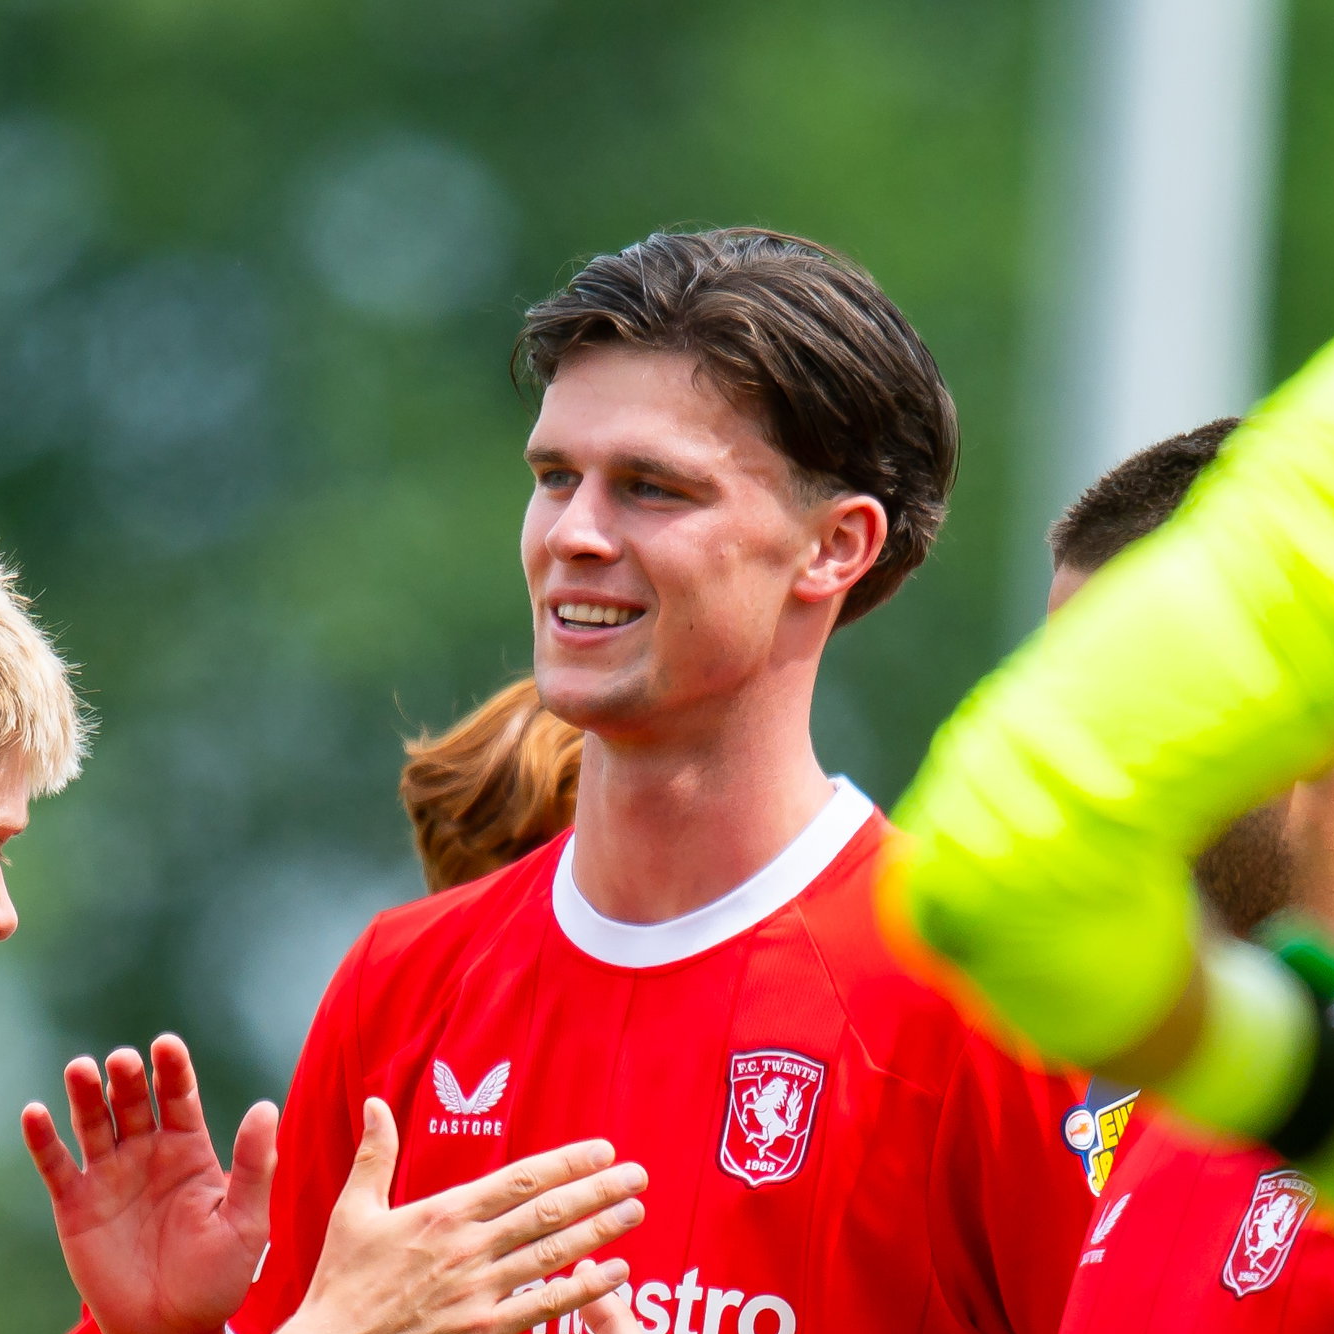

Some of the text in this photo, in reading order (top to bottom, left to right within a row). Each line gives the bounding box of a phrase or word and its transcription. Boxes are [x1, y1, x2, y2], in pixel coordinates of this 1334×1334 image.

[762, 1060, 819, 1083] TWENTE
[429, 1118, 503, 1136] CASTORE
[744, 1160, 776, 1172] 1965
